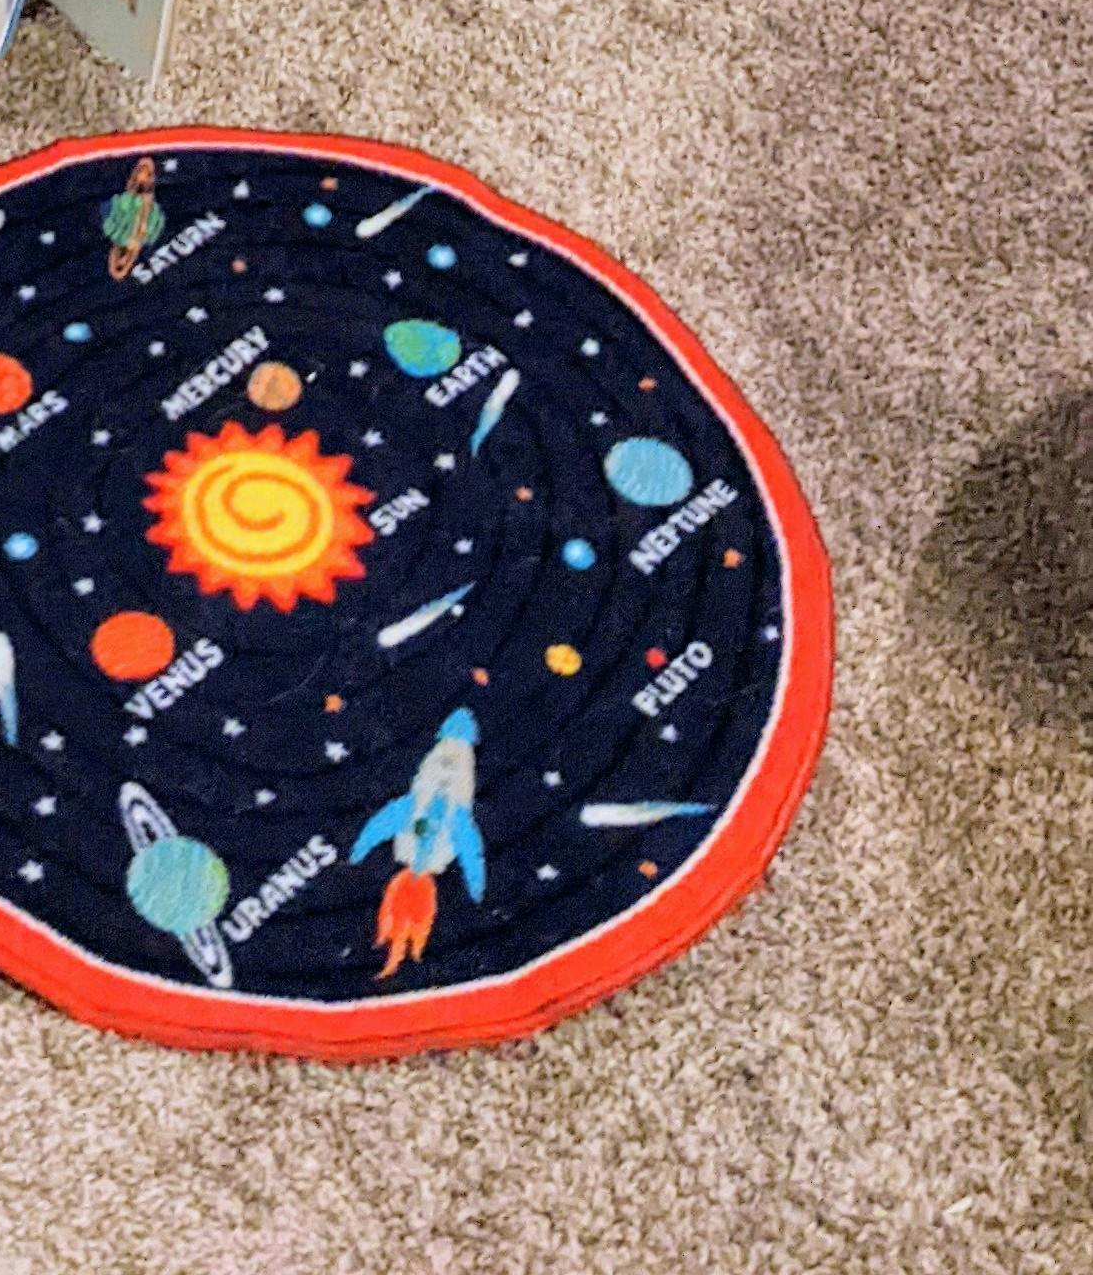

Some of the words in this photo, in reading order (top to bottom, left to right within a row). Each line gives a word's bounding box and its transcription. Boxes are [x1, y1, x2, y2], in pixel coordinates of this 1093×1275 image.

[130, 212, 228, 285] SATURN
[161, 326, 271, 422] MERCURY
[424, 345, 509, 409] EARTH
[368, 487, 430, 538] SUN
[629, 478, 739, 575] NEPTUNE
[123, 638, 225, 721] VENUS
[632, 640, 714, 718] PLUTO
[222, 835, 338, 943] URANUS
